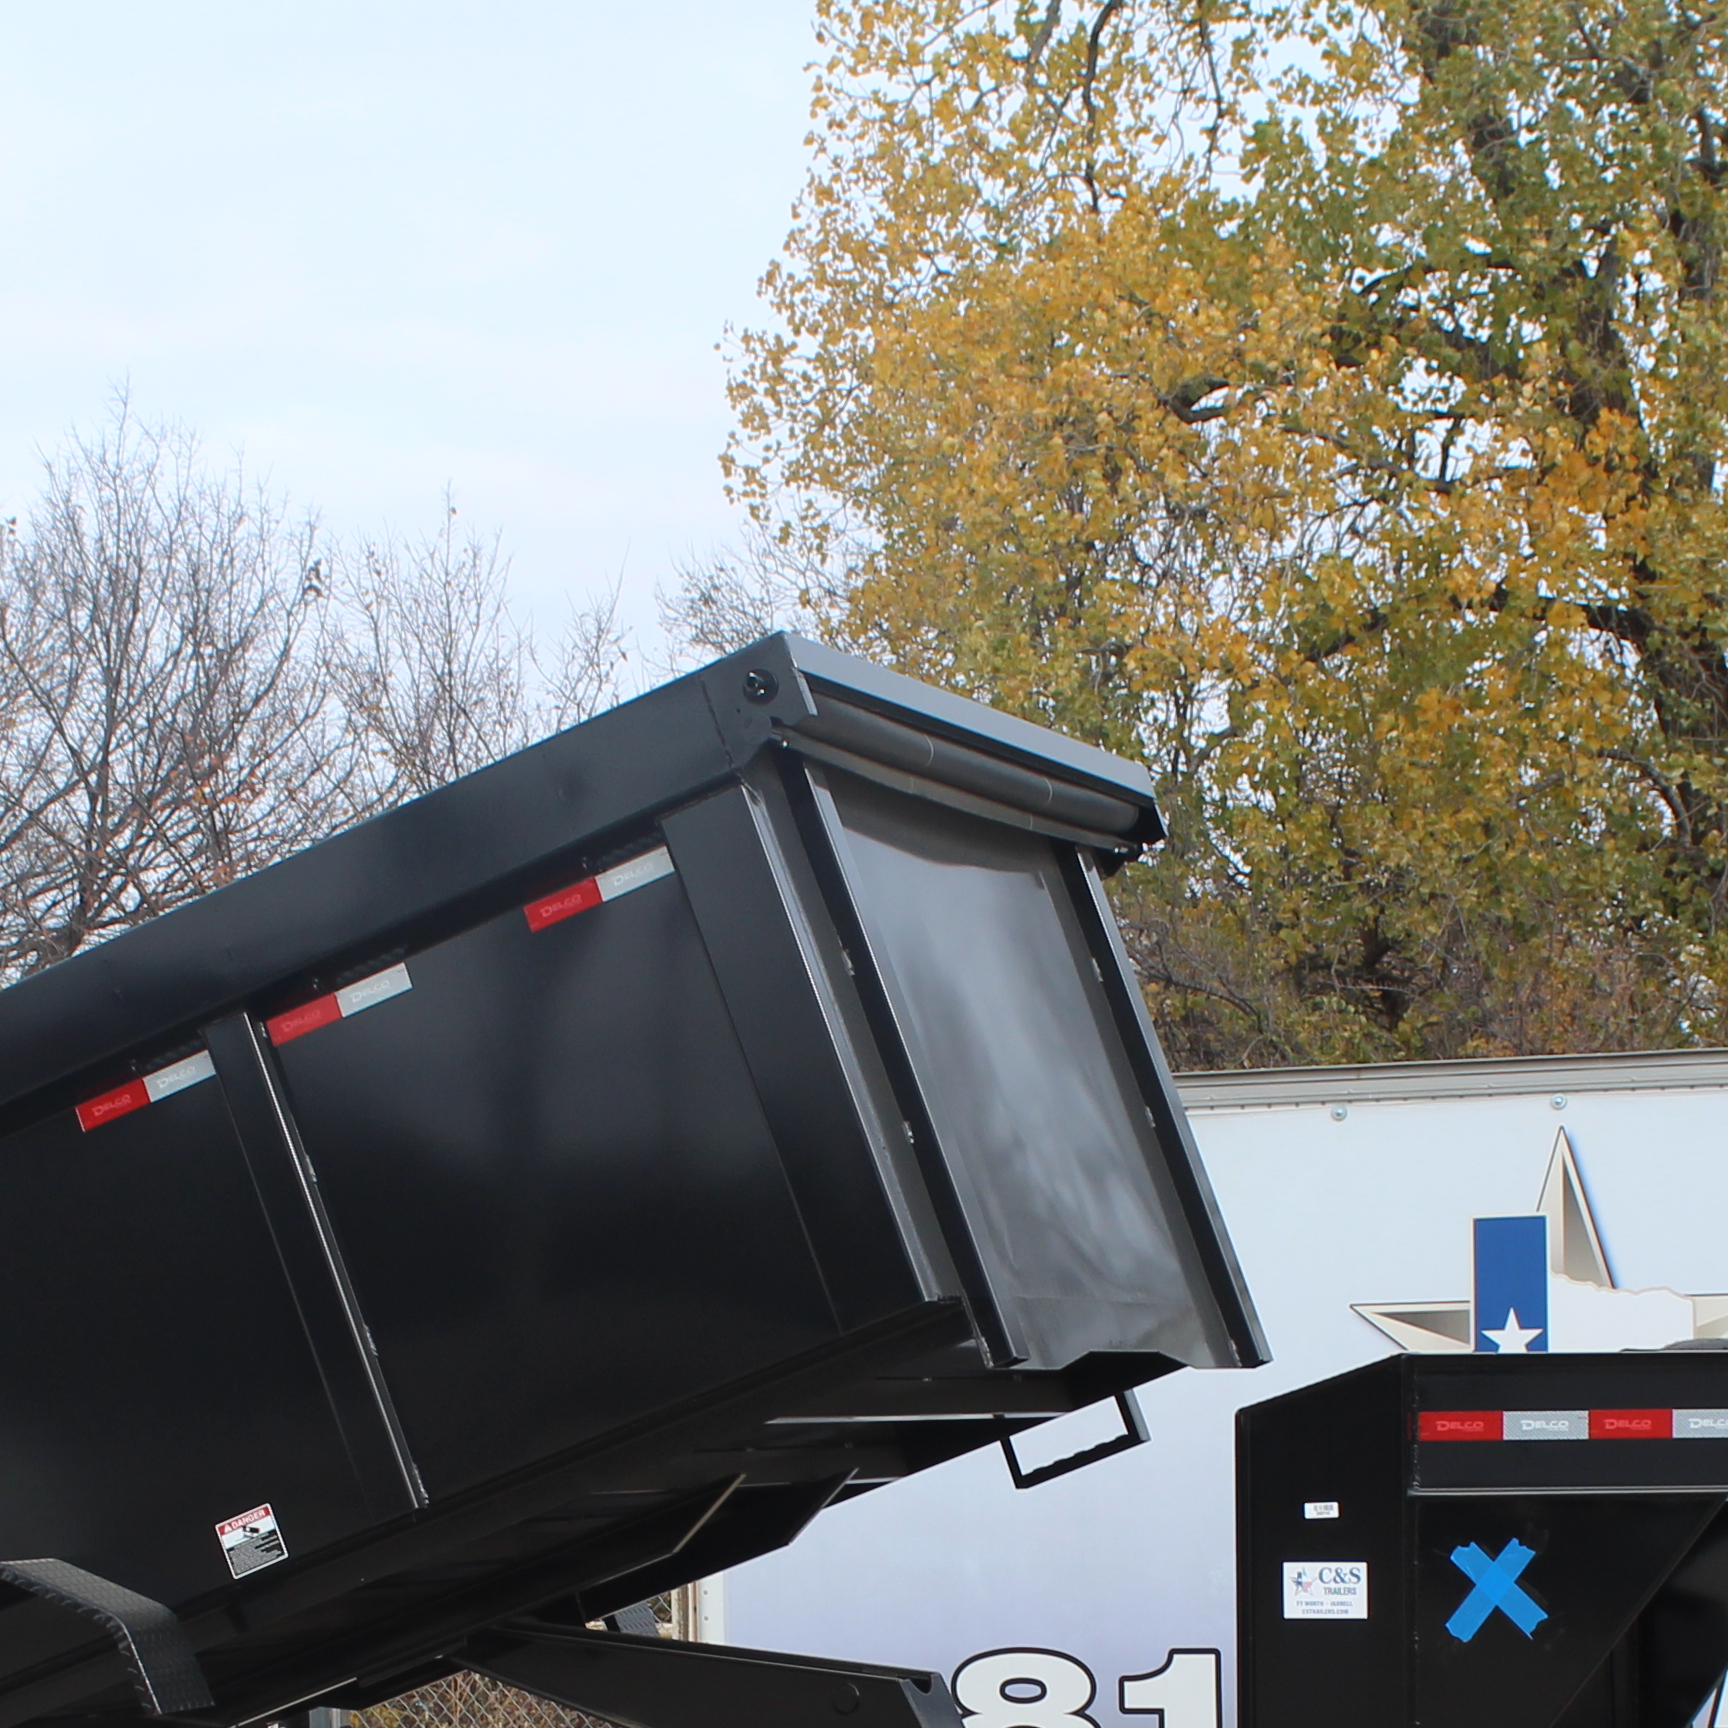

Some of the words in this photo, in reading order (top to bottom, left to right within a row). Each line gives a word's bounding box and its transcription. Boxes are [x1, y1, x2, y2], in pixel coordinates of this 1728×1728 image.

[232, 1508, 266, 1530] DANGER
[1318, 1567, 1362, 1585] C&S
[1323, 1587, 1357, 1595] TRAILERS
